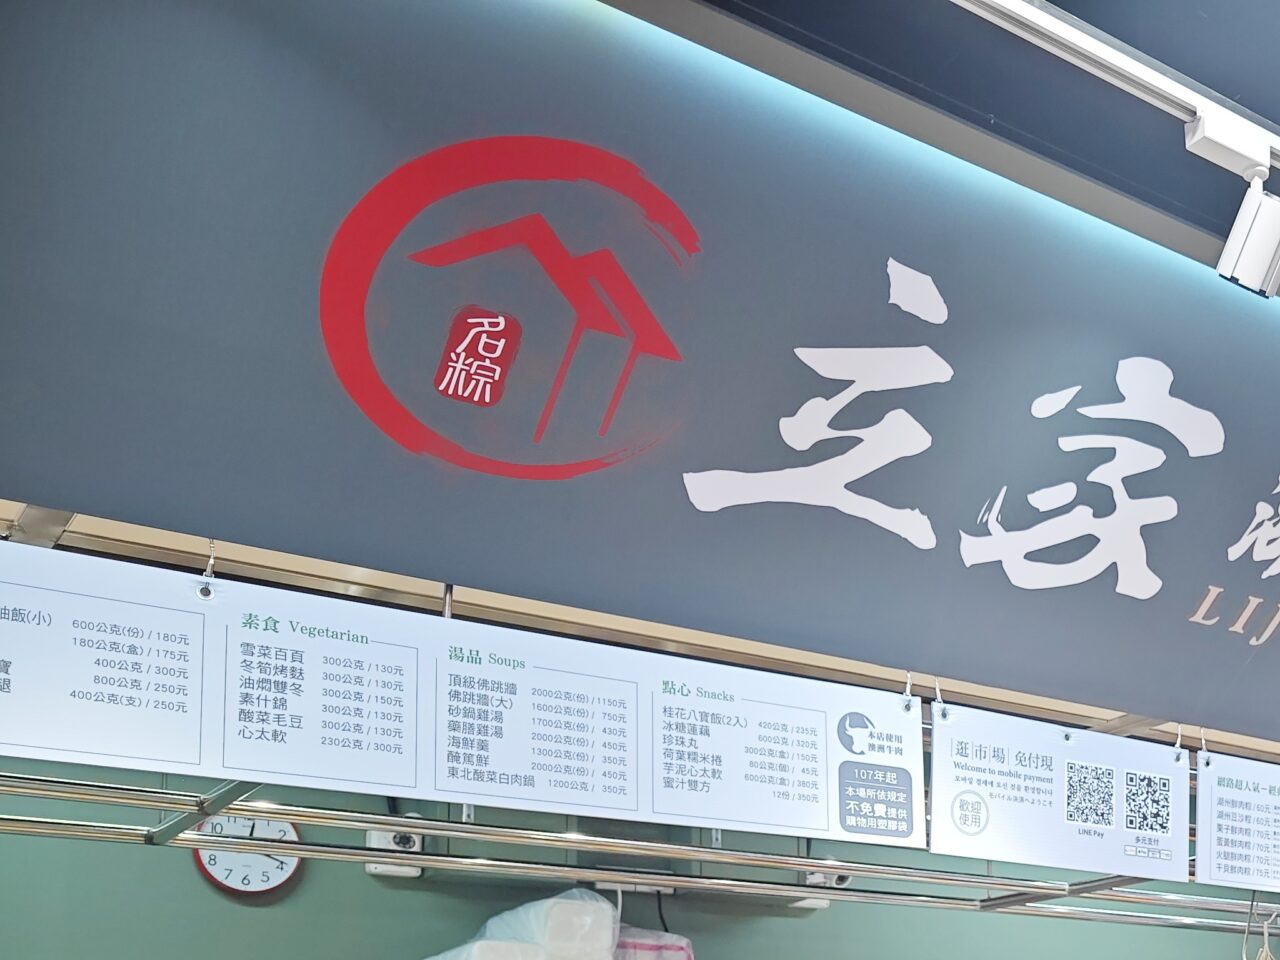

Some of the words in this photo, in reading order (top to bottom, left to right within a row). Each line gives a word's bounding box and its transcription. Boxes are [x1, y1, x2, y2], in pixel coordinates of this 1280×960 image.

[439, 315, 507, 403] 名粽
[241, 613, 280, 633] 素食
[288, 620, 369, 644] Vegetarian
[157, 632, 189, 646] 180元
[156, 649, 189, 662] 175元
[240, 641, 305, 664] 雪菜百頁
[322, 656, 365, 671] 300公克
[375, 664, 404, 676] 130元
[448, 645, 482, 665] 湯品
[488, 653, 526, 670] Soups
[94, 658, 142, 673] 400公克
[155, 666, 188, 679] 300元
[94, 675, 142, 691] 800公克
[154, 683, 188, 696] 250元
[322, 672, 365, 687] 300公克
[375, 679, 404, 692] 130元
[322, 688, 364, 703] 300公克
[375, 695, 404, 708] 150元
[661, 679, 691, 698] 點心
[696, 686, 735, 703] Snacks
[154, 700, 187, 713] 250元
[239, 692, 287, 710] 素什錦
[322, 704, 364, 719] 300公克
[374, 711, 403, 723] 130元
[597, 697, 627, 709] 1150元
[238, 708, 304, 729] 酸菜毛豆
[321, 720, 364, 735] 300公克
[374, 727, 403, 739] 130元
[448, 704, 504, 724] 砂鍋雞湯
[602, 727, 627, 738] 430元
[602, 712, 627, 724] 750元
[758, 721, 789, 733] 420公克
[797, 725, 818, 736] 235元
[238, 725, 287, 744] 心太軟
[321, 737, 363, 751] 230公克
[374, 742, 403, 755] 300元
[602, 742, 627, 752] 450元
[758, 735, 789, 747] 600公克
[797, 739, 818, 750] 320元
[662, 735, 698, 749] 珍珠丸
[797, 752, 819, 763] 150元
[602, 756, 627, 767] 350元
[602, 771, 627, 781] 450元
[662, 763, 722, 780] 芋泥心太軟
[797, 779, 819, 790] 380元
[801, 767, 819, 776] 45元
[953, 761, 987, 773] Welcome
[998, 770, 1022, 779] mobile
[1024, 774, 1053, 784] payment
[548, 779, 589, 792] 1200公克
[602, 785, 627, 796] 350元
[663, 777, 711, 793] 蜜汁雙方
[773, 791, 790, 800] 12份
[797, 793, 819, 803] 350元
[845, 801, 908, 819] 不免費提供
[210, 822, 223, 834] 10
[1078, 828, 1092, 837] LINE
[1093, 829, 1104, 839] Pay
[208, 854, 217, 866] 8
[224, 869, 233, 880] 7
[241, 874, 250, 886] 6
[261, 871, 270, 883] 5
